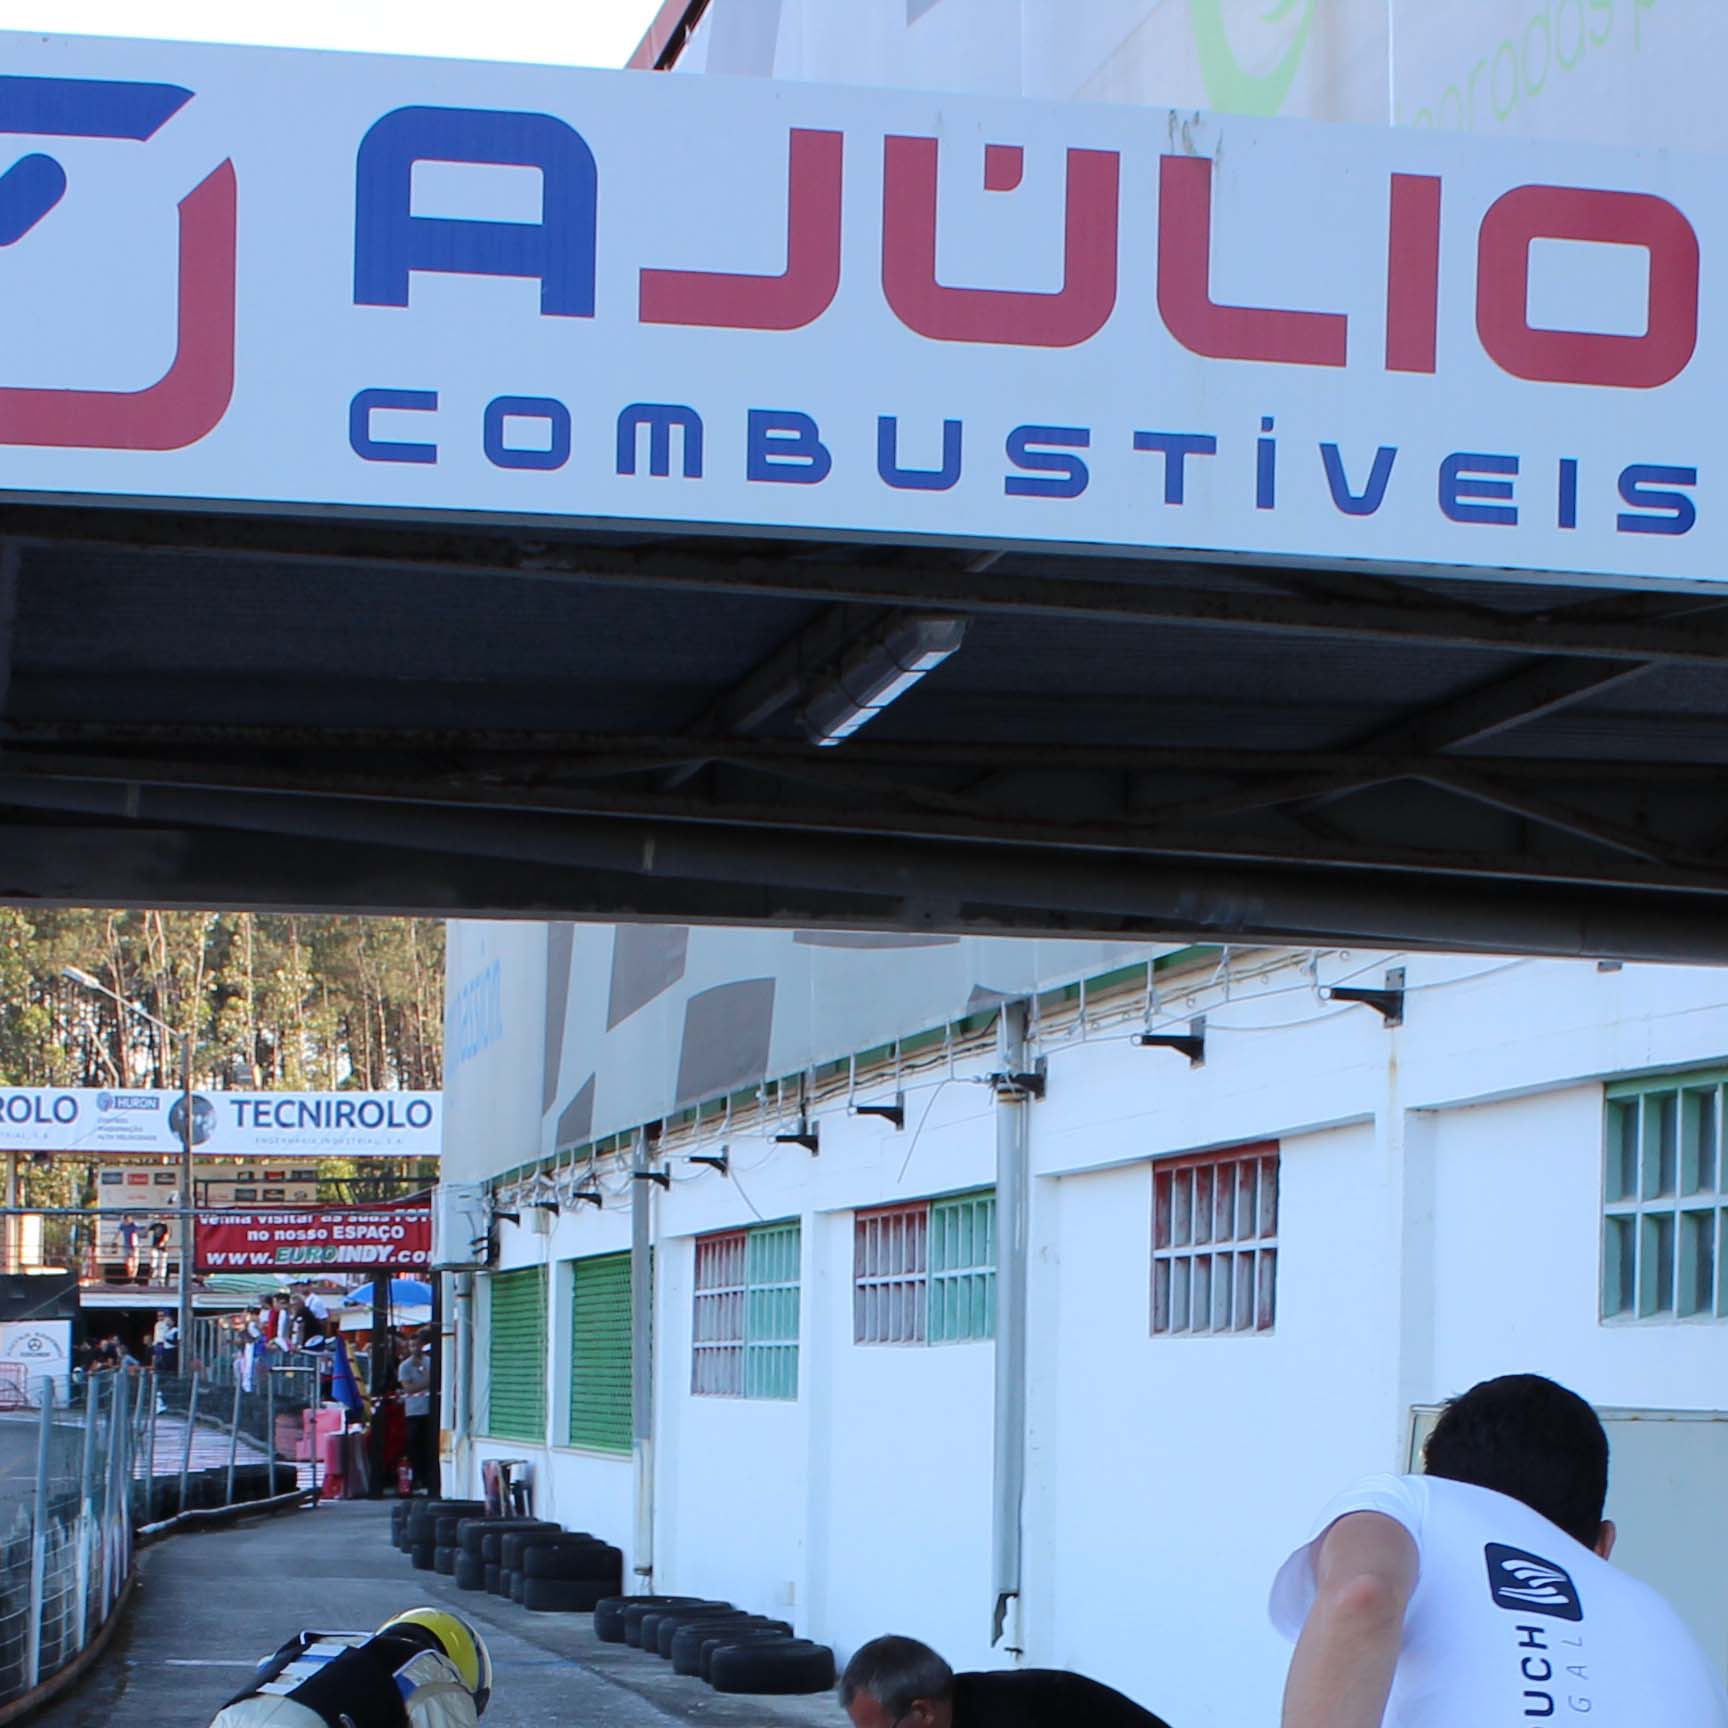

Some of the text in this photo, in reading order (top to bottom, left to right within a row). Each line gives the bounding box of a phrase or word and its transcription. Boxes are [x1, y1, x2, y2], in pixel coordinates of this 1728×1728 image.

[229, 1099, 434, 1129] TECNIROLO
[247, 1225, 405, 1243] no nosso ESPAÇO
